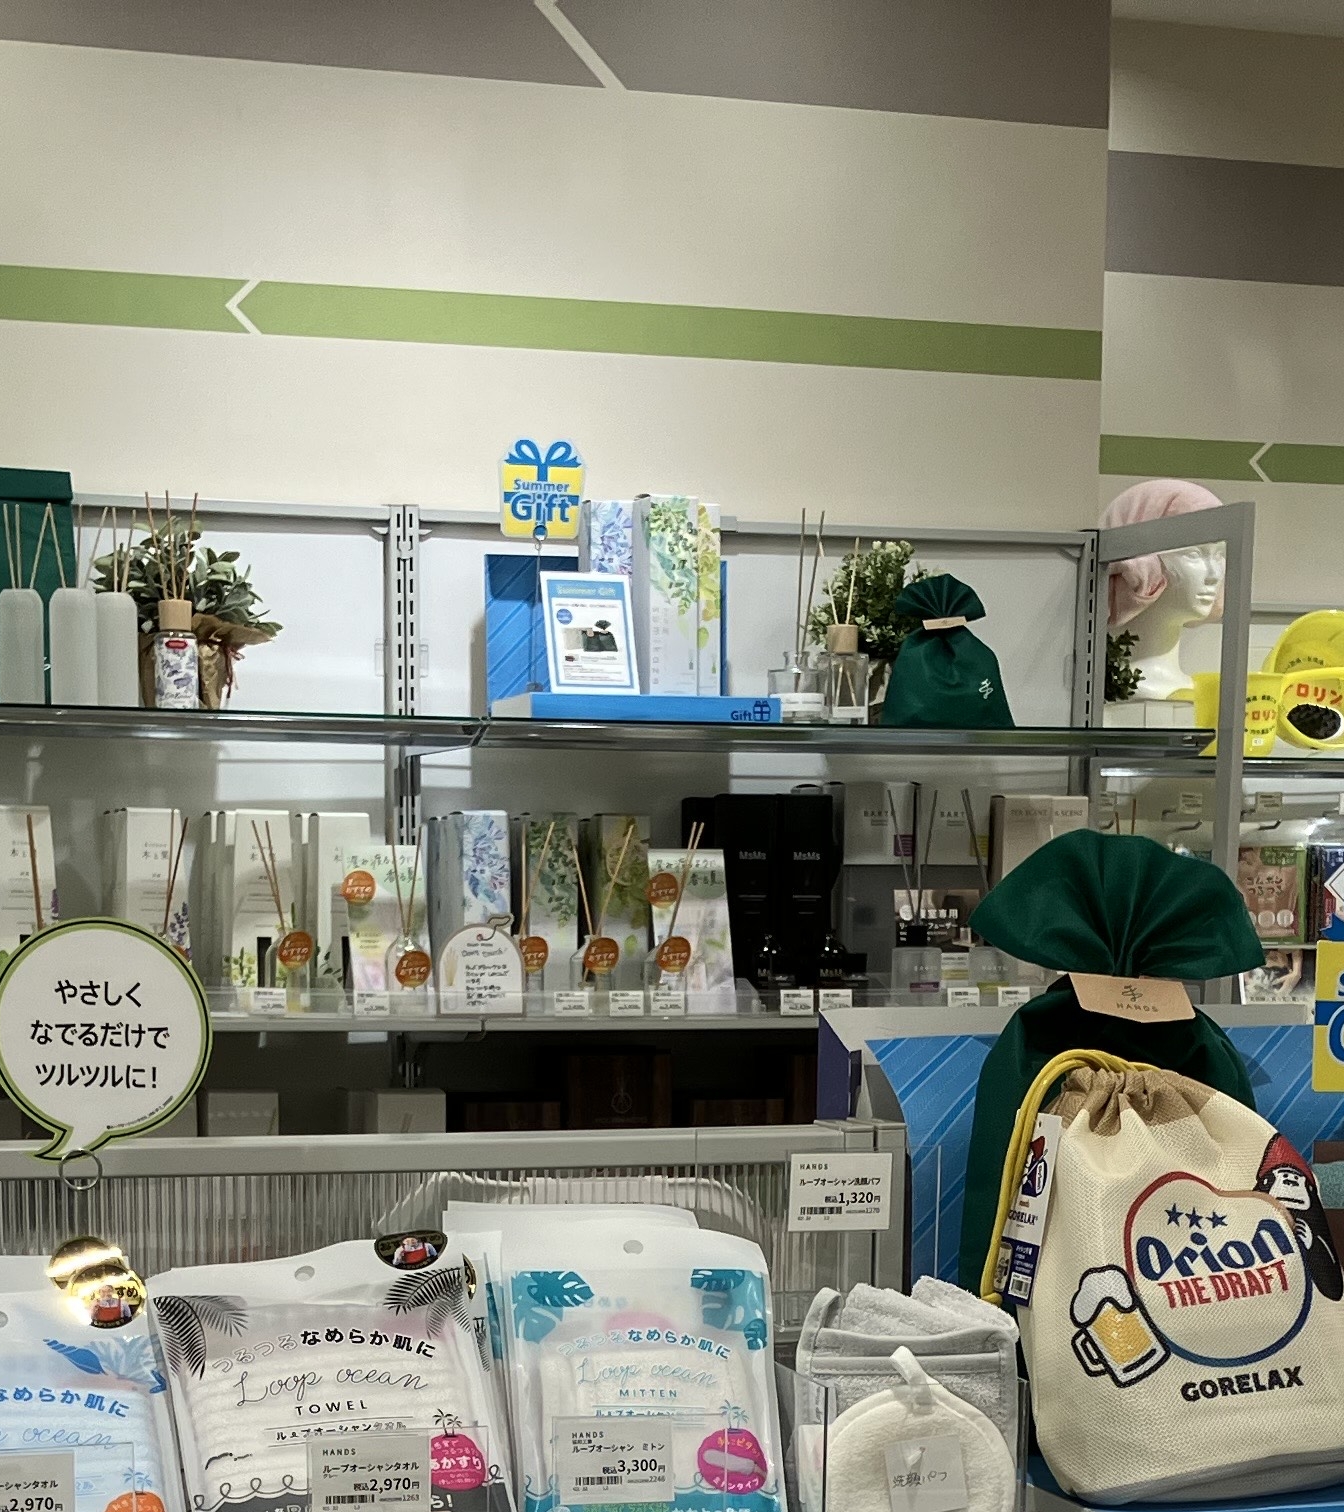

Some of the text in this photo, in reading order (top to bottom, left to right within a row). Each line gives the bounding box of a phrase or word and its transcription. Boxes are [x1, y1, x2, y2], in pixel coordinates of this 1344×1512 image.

[513, 477, 570, 494] Summer
[510, 493, 571, 524] Gift
[730, 708, 753, 722] Gift
[54, 979, 142, 1008] やさしく
[1116, 1001, 1159, 1013] HANDS
[30, 1020, 170, 1050] なでるだけで
[35, 1063, 159, 1090] ツルツルに！
[799, 1162, 829, 1171] HANDS
[799, 1177, 882, 1188] ループオーシャン洗顔パフ
[1135, 1218, 1296, 1281] Orion
[1157, 1260, 1290, 1310] THE DRAFT
[211, 1327, 437, 1374] つるつるなめらか肌に
[557, 1327, 732, 1361] つるつるなめらか肌に
[575, 1357, 719, 1386] Loop ocean
[234, 1366, 429, 1407] Loop ocean
[618, 1388, 679, 1398] MITTEN
[1180, 1366, 1305, 1403] GORELAX
[294, 1400, 369, 1416] TOWEL
[22, 1422, 117, 1450] ocean
[571, 1431, 605, 1439] HANDS
[322, 1448, 357, 1457] HANDS
[571, 1442, 666, 1453] ループオーシャン ミトン
[322, 1462, 420, 1475] ループオーシャンタオル
[602, 1458, 666, 1475] 税込3,300円
[353, 1477, 420, 1493] 税込2,970円
